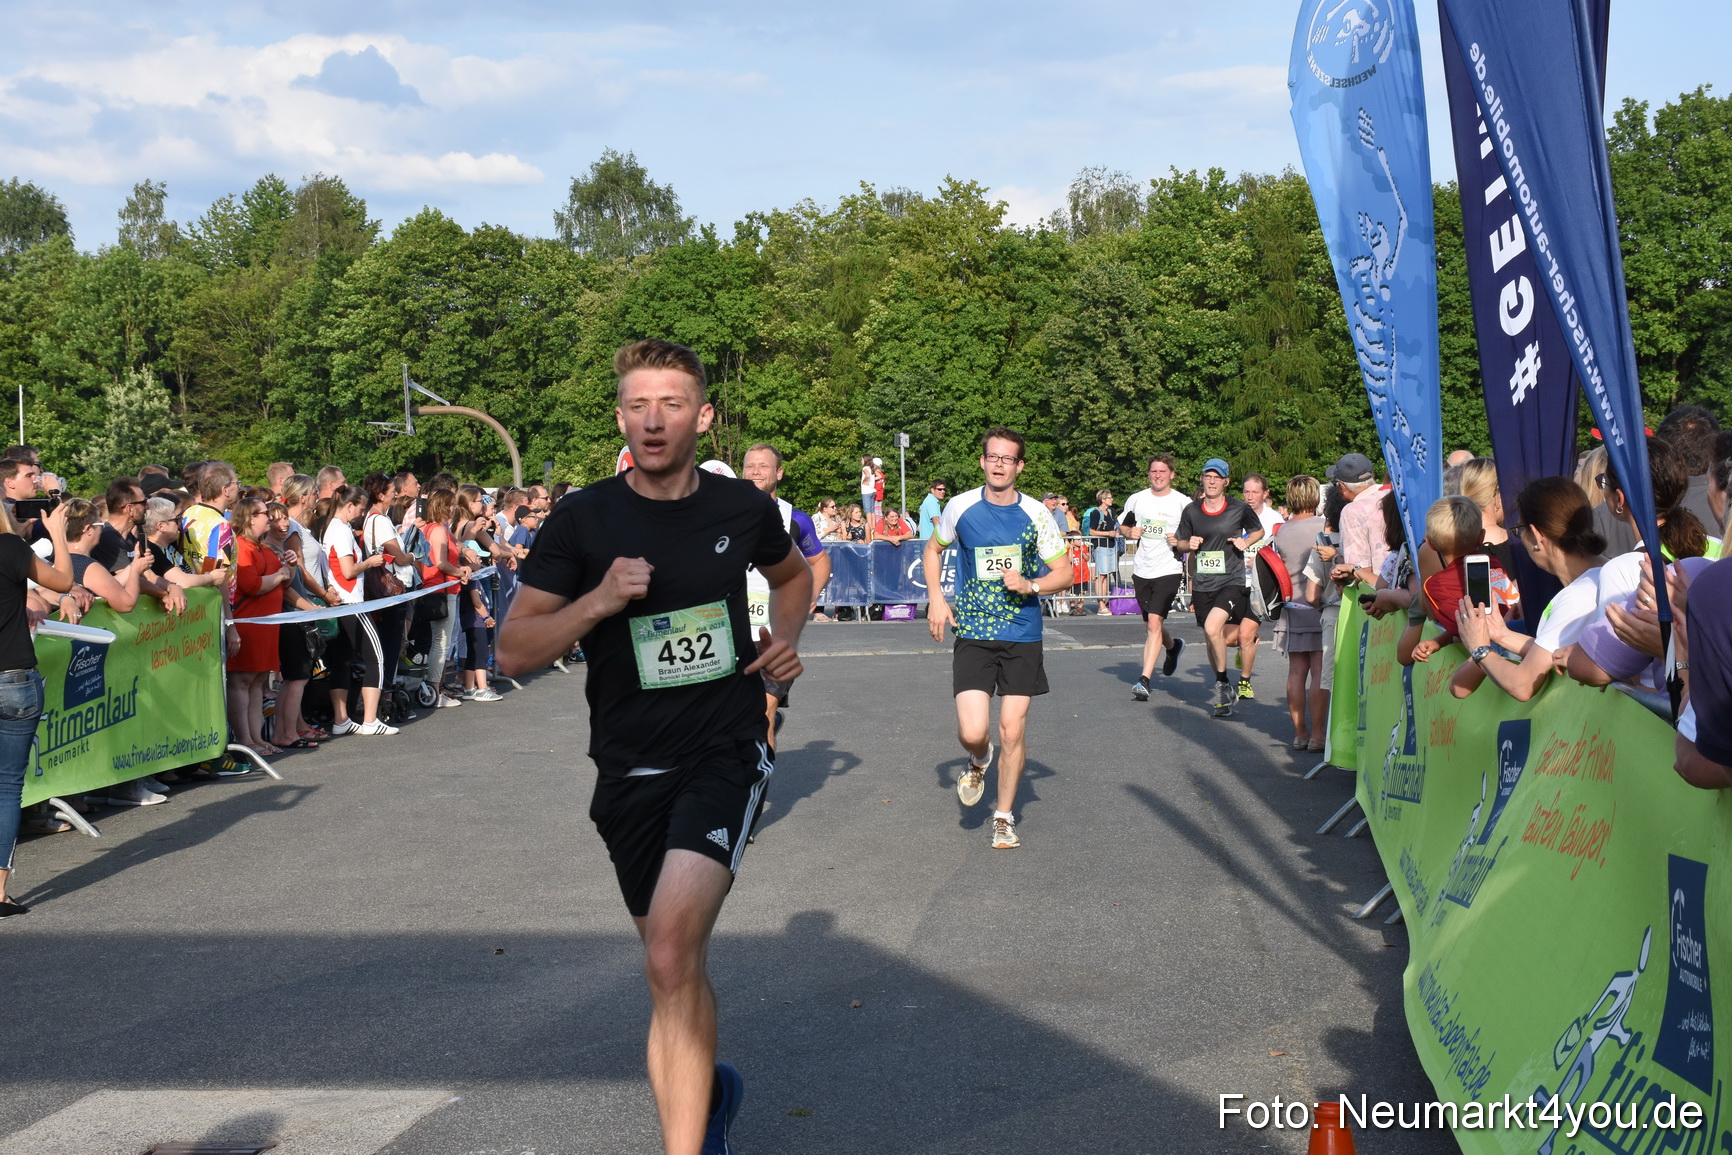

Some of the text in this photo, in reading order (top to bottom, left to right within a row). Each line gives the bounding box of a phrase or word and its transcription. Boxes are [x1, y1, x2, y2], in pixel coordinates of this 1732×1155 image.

[1143, 524, 1163, 535] 2369
[986, 557, 1012, 571] 256
[1200, 559, 1221, 568] 1492
[657, 632, 716, 666] 432
[74, 653, 102, 672] Fischer
[657, 659, 721, 676] Braun Alexander
[682, 669, 706, 679] Ingenieur
[706, 665, 722, 674] GmbH
[46, 675, 139, 751] firmenlauf
[47, 739, 90, 770] neumarkt
[112, 726, 220, 772] www.firmenlauf-oberpfalz.de
[1502, 761, 1522, 784] Fischer
[706, 830, 730, 852] adidas
[1676, 922, 1702, 970] Fischer
